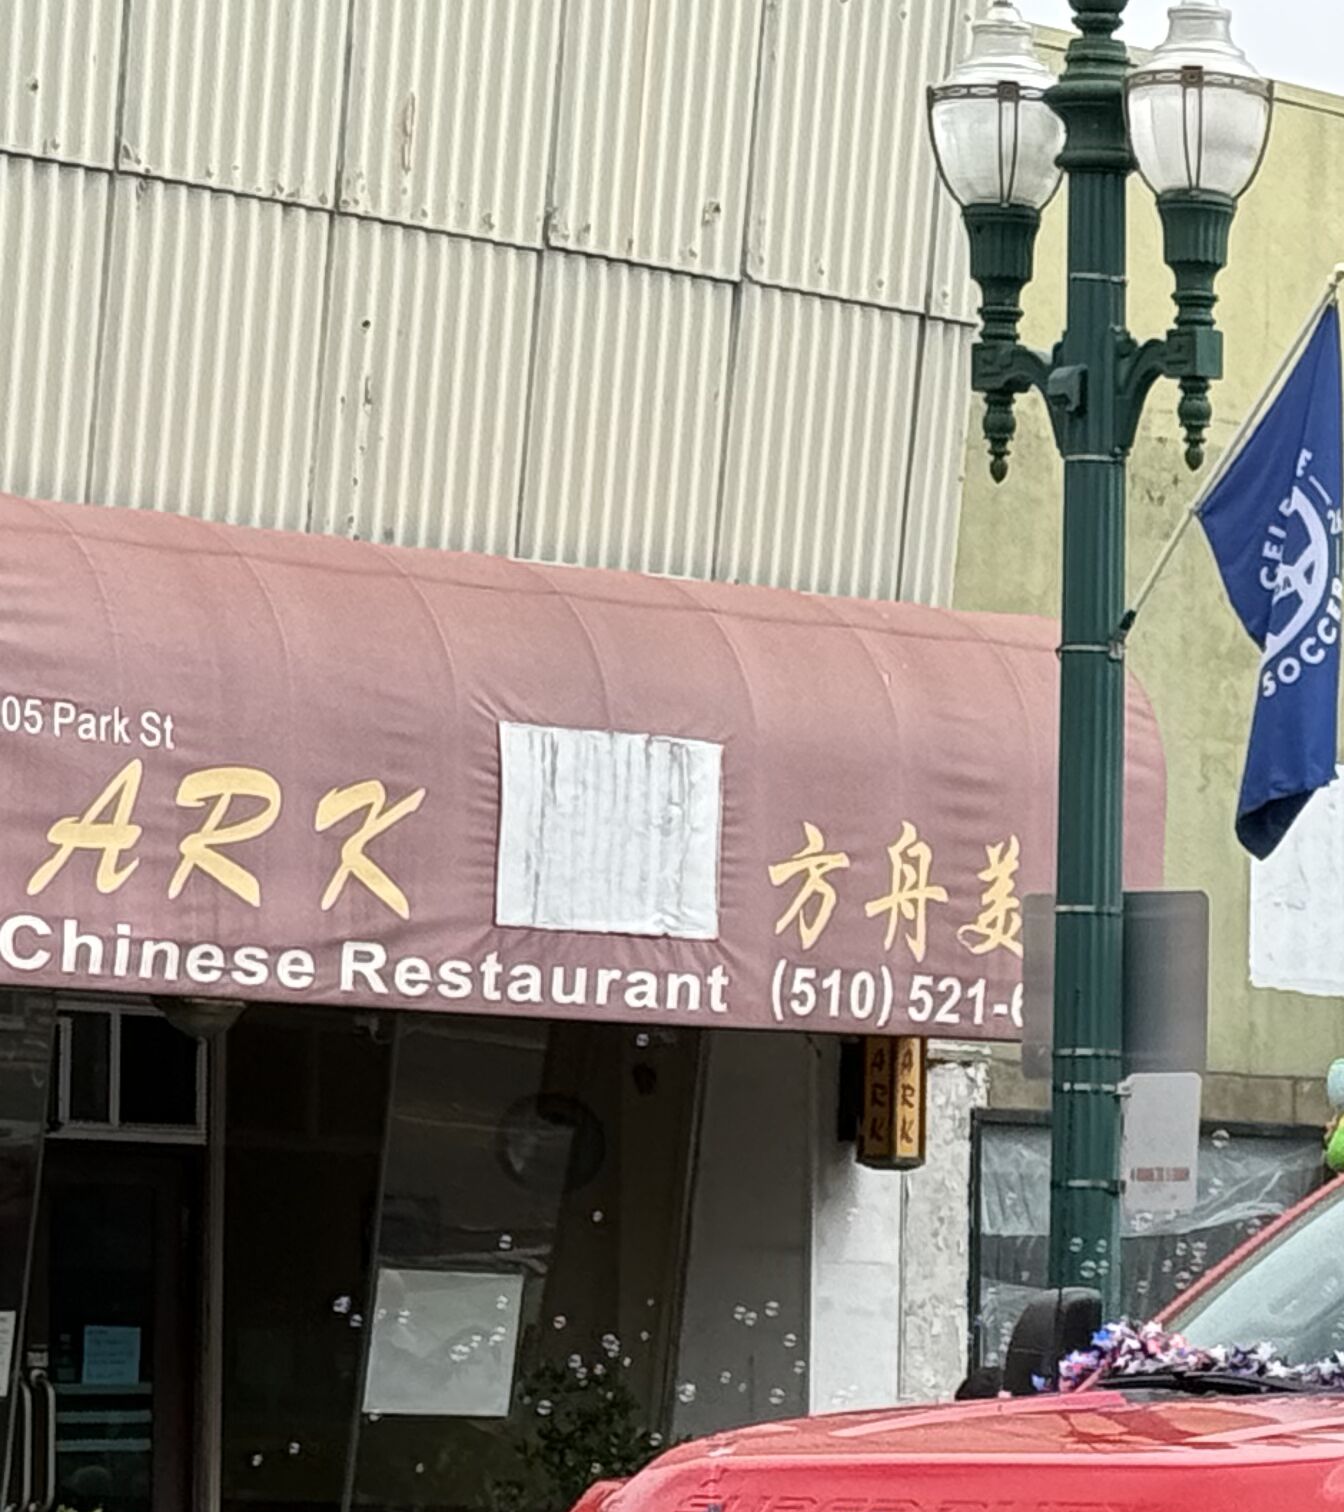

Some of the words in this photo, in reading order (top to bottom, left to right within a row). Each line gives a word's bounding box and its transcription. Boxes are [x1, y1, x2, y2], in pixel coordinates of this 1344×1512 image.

[53, 701, 131, 744] Park
[139, 708, 175, 750] St
[26, 757, 427, 920] ARK
[0, 914, 315, 989] Chinese
[339, 940, 730, 1014] Restaurant
[771, 959, 893, 1027] (510)
[900, 1048, 915, 1144] ARK
